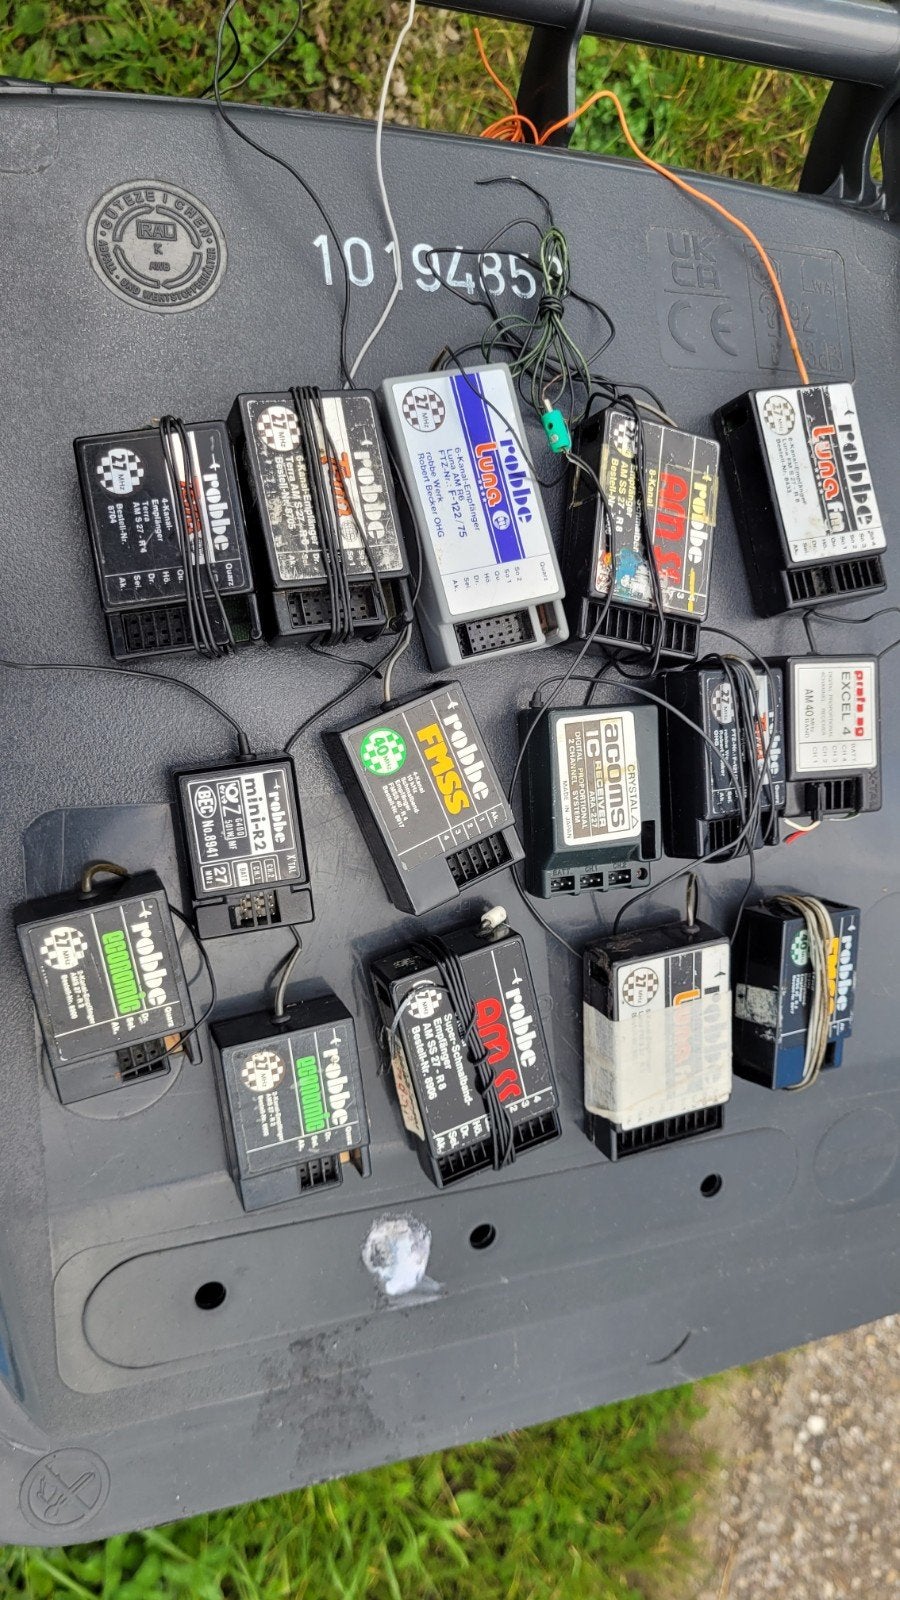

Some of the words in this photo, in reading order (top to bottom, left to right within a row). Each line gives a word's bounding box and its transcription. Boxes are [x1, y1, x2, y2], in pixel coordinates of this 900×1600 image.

[140, 224, 177, 239] RAL
[153, 243, 163, 255] K
[309, 233, 572, 302] 1019485
[414, 394, 429, 409] 27
[271, 413, 286, 429] 27
[421, 412, 429, 428] MHz
[278, 431, 286, 447] MHz
[110, 454, 127, 470] 27
[446, 448, 456, 470] Luna
[619, 460, 627, 477] AM
[810, 423, 850, 500] Luna
[117, 473, 125, 490] MHz
[285, 456, 295, 481] Terra
[290, 483, 300, 499] AM
[425, 451, 436, 476] robbe
[432, 479, 443, 502] Werk
[452, 472, 461, 486] AM
[474, 440, 509, 507] Luna
[499, 436, 532, 522] robbe
[618, 479, 626, 494] SS
[837, 423, 872, 524] robbe
[353, 450, 386, 539] robbe
[417, 452, 430, 482] Robert
[425, 484, 437, 514] Becker
[433, 516, 444, 537] OHG
[454, 446, 479, 530] 6-Kanal-Empfänger
[456, 488, 464, 501] R6
[107, 505, 116, 523] 8704
[132, 501, 140, 514] AM
[141, 501, 150, 522] Terra
[202, 472, 230, 550] robbe
[617, 496, 625, 508] 27
[655, 473, 688, 540] AM
[115, 503, 127, 544] Bestell-Nr.
[135, 523, 144, 533] 27
[150, 498, 163, 541] Empfänger
[615, 516, 623, 524] R
[687, 481, 709, 563] robbe
[826, 500, 845, 532] fm
[118, 576, 126, 591] Ak.
[224, 563, 234, 586] Quarz
[504, 568, 510, 578] So
[514, 566, 519, 575] So
[539, 561, 548, 580] Quarz
[720, 689, 729, 704] 27
[804, 689, 813, 702] AM
[841, 671, 850, 720] EXCEL
[805, 705, 813, 716] 40
[842, 726, 850, 735] 4
[373, 737, 389, 756] 40
[382, 755, 391, 769] MHz
[442, 713, 489, 800] robbe
[574, 731, 582, 761] DIGITAL
[416, 722, 469, 814] FMSS
[568, 745, 577, 784] CHANNEL
[604, 723, 625, 827] acoms
[585, 730, 600, 757] IC
[594, 760, 606, 827] RECEIVER
[626, 764, 637, 812] CRYSTAL
[196, 789, 215, 814] BEC
[221, 804, 241, 817] Z
[572, 789, 580, 823] SYSTEM
[577, 767, 588, 829] PROPORTIONAL
[588, 790, 597, 827] ARA-227
[244, 777, 266, 850] mini-R2
[268, 790, 287, 843] robbe
[490, 810, 498, 822] Ak.
[213, 866, 227, 883] 27
[53, 931, 71, 947] 27
[62, 950, 70, 965] MHz
[101, 928, 146, 1013] economic
[130, 921, 167, 1005] robbe
[834, 934, 853, 1011] robbe
[635, 974, 646, 987] 27
[422, 1022, 433, 1039] AM
[475, 997, 510, 1064] AM
[505, 987, 536, 1067] robbe
[426, 1039, 437, 1055] SS
[432, 1017, 451, 1069] Empfänger
[254, 1056, 269, 1070] 27
[411, 1025, 429, 1076] Bestell-Nr.
[424, 1076, 437, 1100] 8906
[430, 1055, 441, 1066] 27
[443, 1012, 473, 1106] Super-Schmalband-
[322, 1047, 350, 1125] robbe
[435, 1074, 444, 1084] R
[295, 1054, 332, 1132] economic
[520, 1099, 529, 1108] 3
[533, 1095, 541, 1103] 4
[508, 1104, 516, 1113] 2
